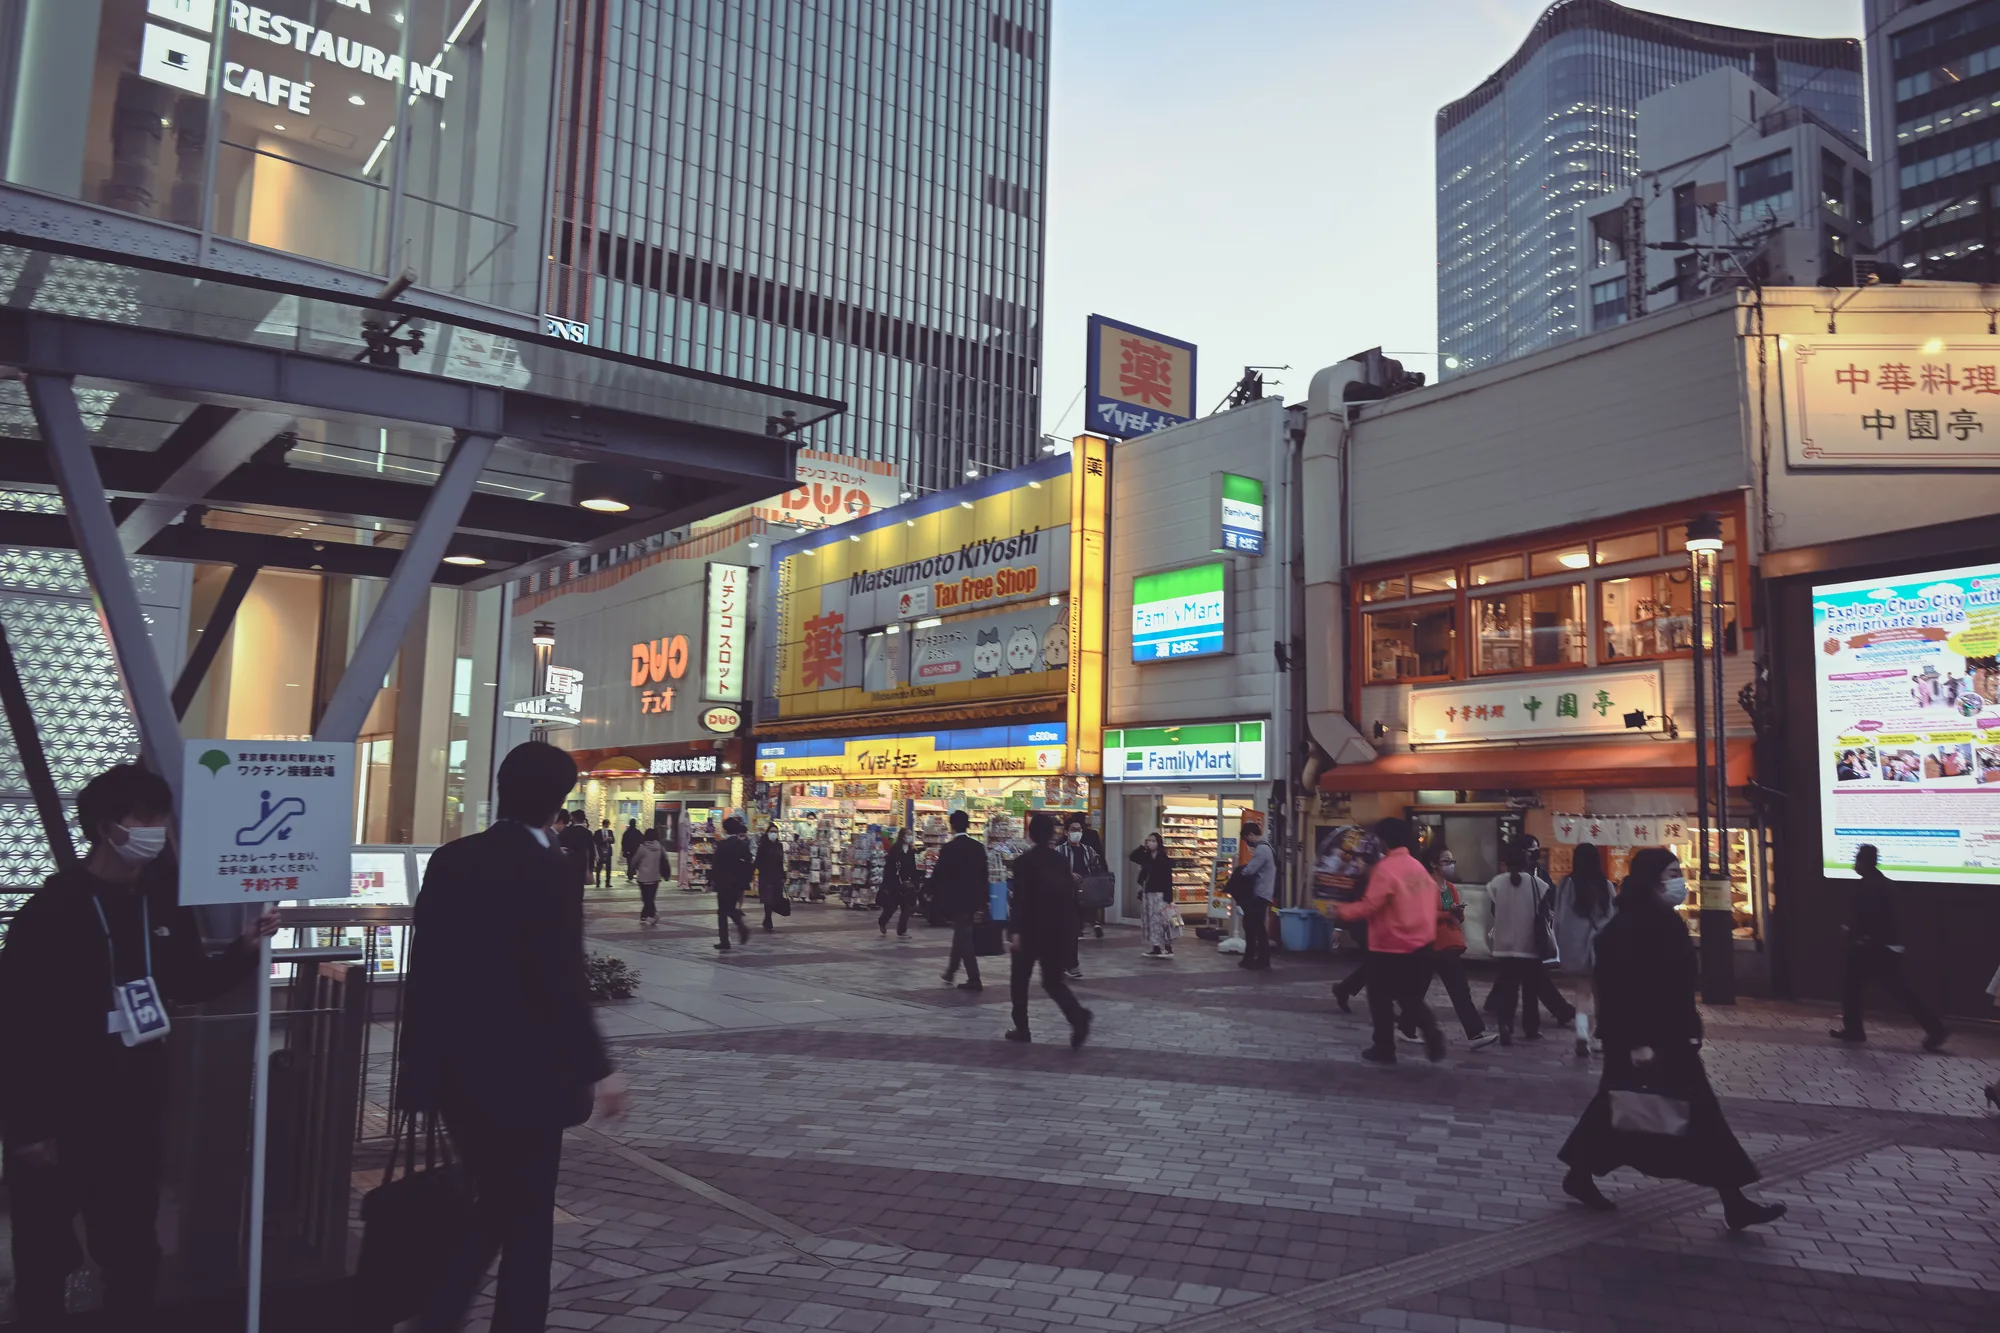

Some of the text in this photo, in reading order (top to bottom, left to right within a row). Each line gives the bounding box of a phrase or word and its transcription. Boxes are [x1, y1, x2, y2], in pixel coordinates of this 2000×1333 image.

[230, 1, 453, 99] RESTAURANT
[1119, 338, 1173, 408] 薬
[1835, 362, 2000, 395] 中華料理
[1862, 408, 1984, 441] 中園亭
[831, 471, 866, 486] スロット
[1086, 457, 1102, 477] 薬
[782, 482, 871, 518] DUO
[1224, 506, 1260, 521] FamilyMart
[850, 554, 954, 596] Matsumoto
[958, 526, 1039, 571] KiYoshi
[935, 583, 959, 609] Tax
[961, 575, 993, 603] Free
[996, 566, 1038, 596] Shop
[1137, 600, 1220, 629] FamiyMart
[1827, 604, 1884, 619] Explore
[1888, 598, 1927, 613] Chuo
[1932, 594, 1965, 608] City
[717, 567, 737, 695] パチンコ スロット
[1828, 615, 1915, 634] semiprivate
[1921, 610, 1965, 627] guide
[631, 634, 689, 687] DUO
[802, 611, 844, 688] 薬
[708, 714, 738, 725] DUO
[1445, 704, 1504, 722] 中華料理
[238, 766, 335, 777] ワクチン接種会場
[936, 760, 988, 773] Matsumoto
[1149, 750, 1232, 772] FamilyMart
[219, 852, 318, 862] エスカレーターをおり、
[241, 877, 299, 892] 予約不要
